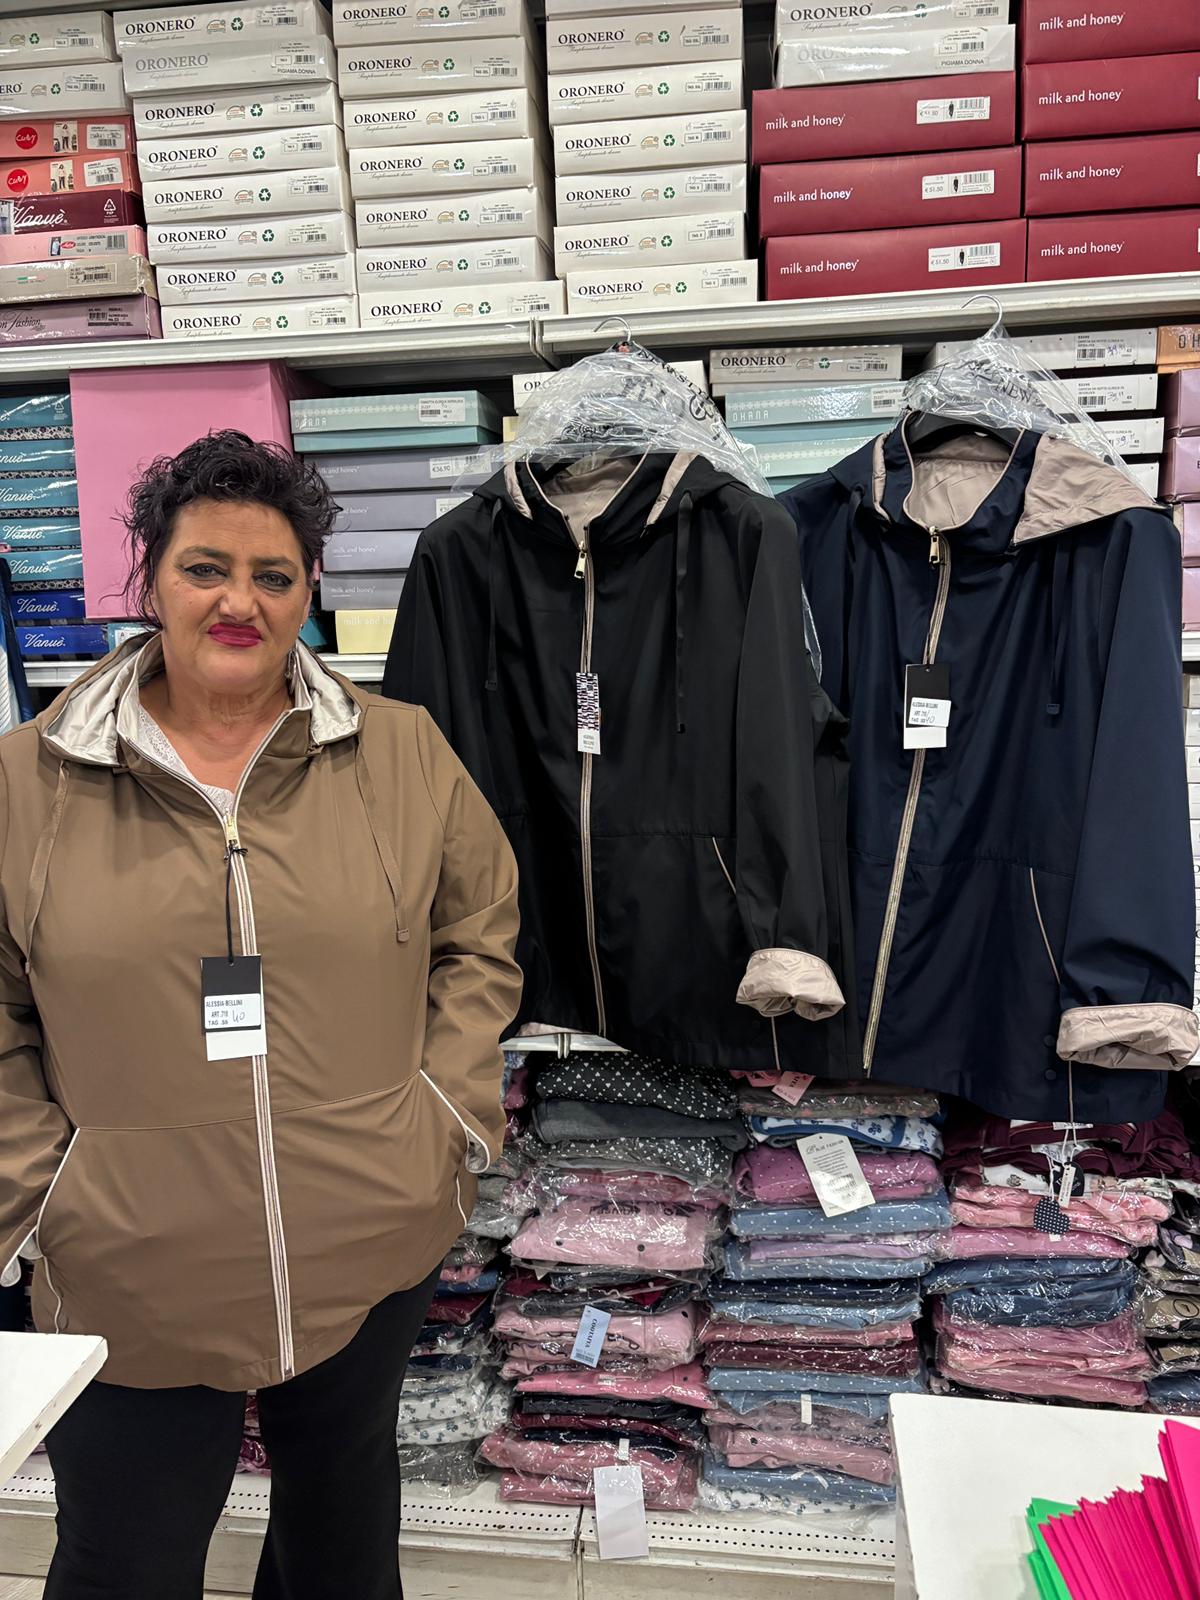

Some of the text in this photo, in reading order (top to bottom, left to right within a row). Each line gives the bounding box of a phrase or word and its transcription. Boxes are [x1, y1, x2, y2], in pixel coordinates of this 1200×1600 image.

[343, 6, 406, 20] ORONERO
[790, 4, 871, 21] ORONERO
[126, 18, 195, 35] ORONERO
[1039, 13, 1123, 30] milk and honey
[558, 31, 624, 44] ORONERO
[136, 54, 208, 71] ORONERO
[348, 58, 411, 71] ORONERO
[559, 83, 624, 98] ORONERO
[1039, 89, 1121, 105] milk and honey
[145, 104, 214, 121] ORONERO
[354, 110, 416, 124] ORONERO
[765, 115, 844, 130] milk and honey
[565, 135, 630, 150] ORONERO
[149, 147, 217, 163] ORONERO
[360, 158, 422, 171] ORONERO
[1039, 165, 1121, 180] milk and honey
[155, 188, 223, 204] ORONERO
[566, 187, 631, 202] ORONERO
[773, 188, 851, 203] milk and honey
[366, 210, 427, 223] ORONERO
[158, 229, 226, 243] ORONERO
[565, 236, 629, 251] ORONERO
[1041, 242, 1123, 257] milk and honey
[366, 258, 427, 272] ORONERO
[780, 260, 857, 275] milk and honey
[167, 271, 236, 285] ORONERO
[578, 281, 643, 296] ORONERO
[371, 301, 442, 316] ORONERO
[173, 315, 240, 329] ORONERO
[721, 356, 786, 367] ORONERO
